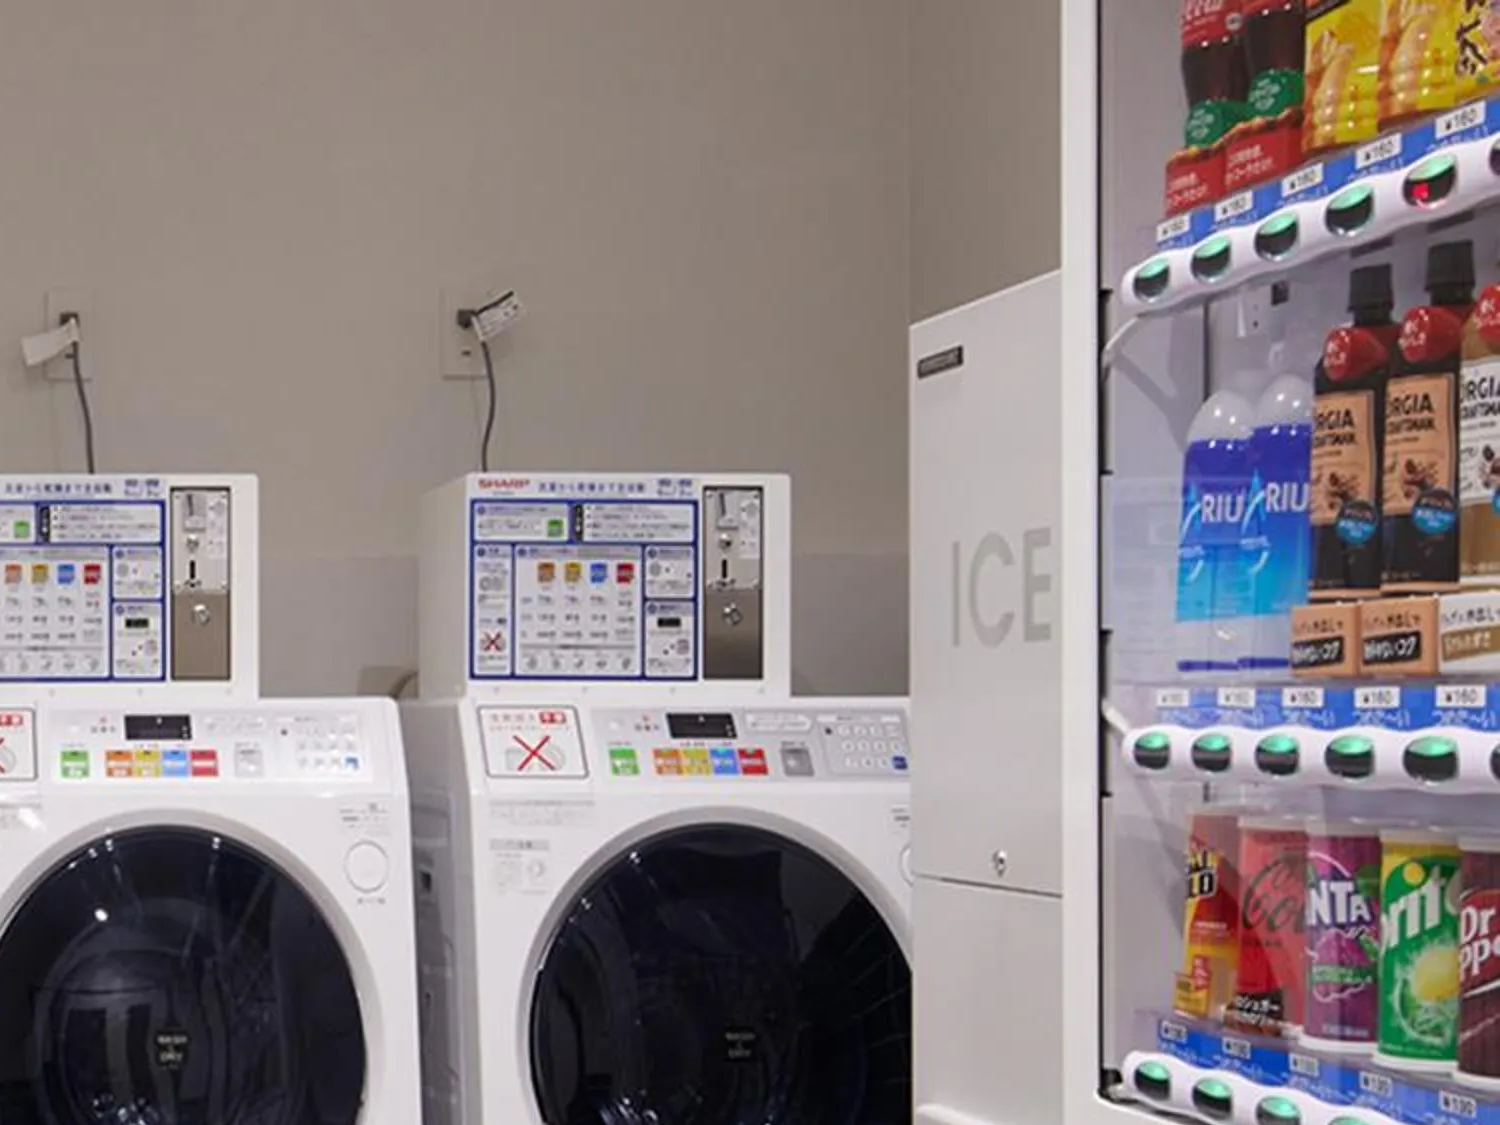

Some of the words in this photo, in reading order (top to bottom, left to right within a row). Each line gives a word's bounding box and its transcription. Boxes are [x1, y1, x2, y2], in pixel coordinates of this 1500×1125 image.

[478, 478, 531, 489] SHARP
[952, 527, 1051, 649] ICE
[1460, 904, 1497, 945] Dr
